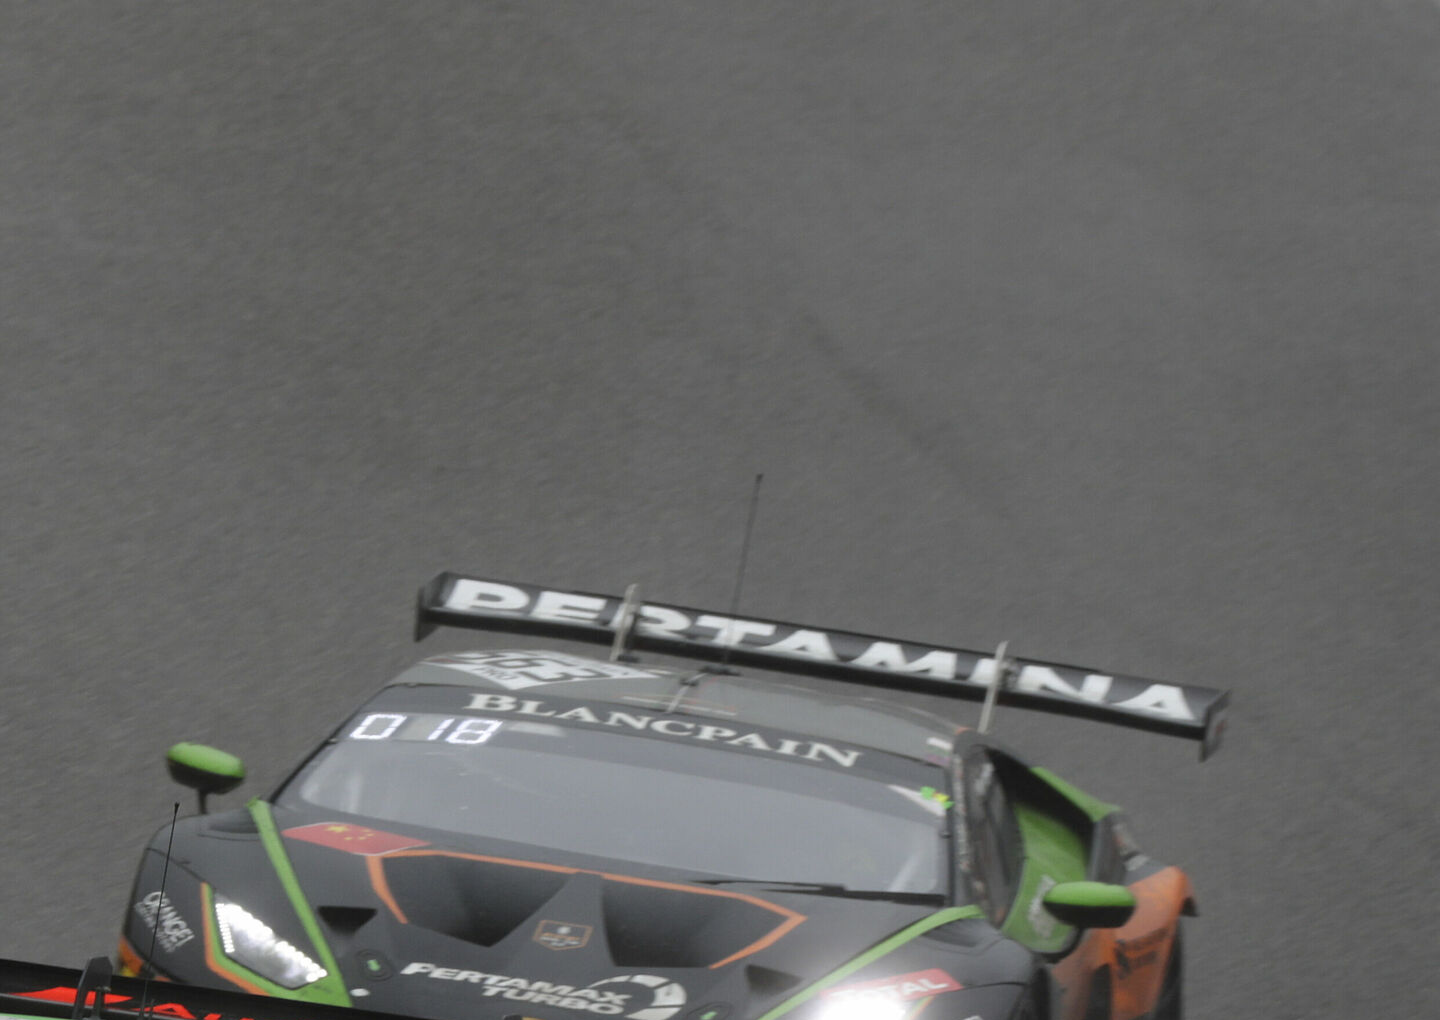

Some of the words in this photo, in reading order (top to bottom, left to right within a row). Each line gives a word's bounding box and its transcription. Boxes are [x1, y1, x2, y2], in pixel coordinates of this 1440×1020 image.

[442, 577, 1195, 721] PERTAMINA
[463, 693, 864, 768] BLANCPAIN
[400, 961, 633, 1006] PERTAMAX
[482, 985, 625, 1016] TURBO
